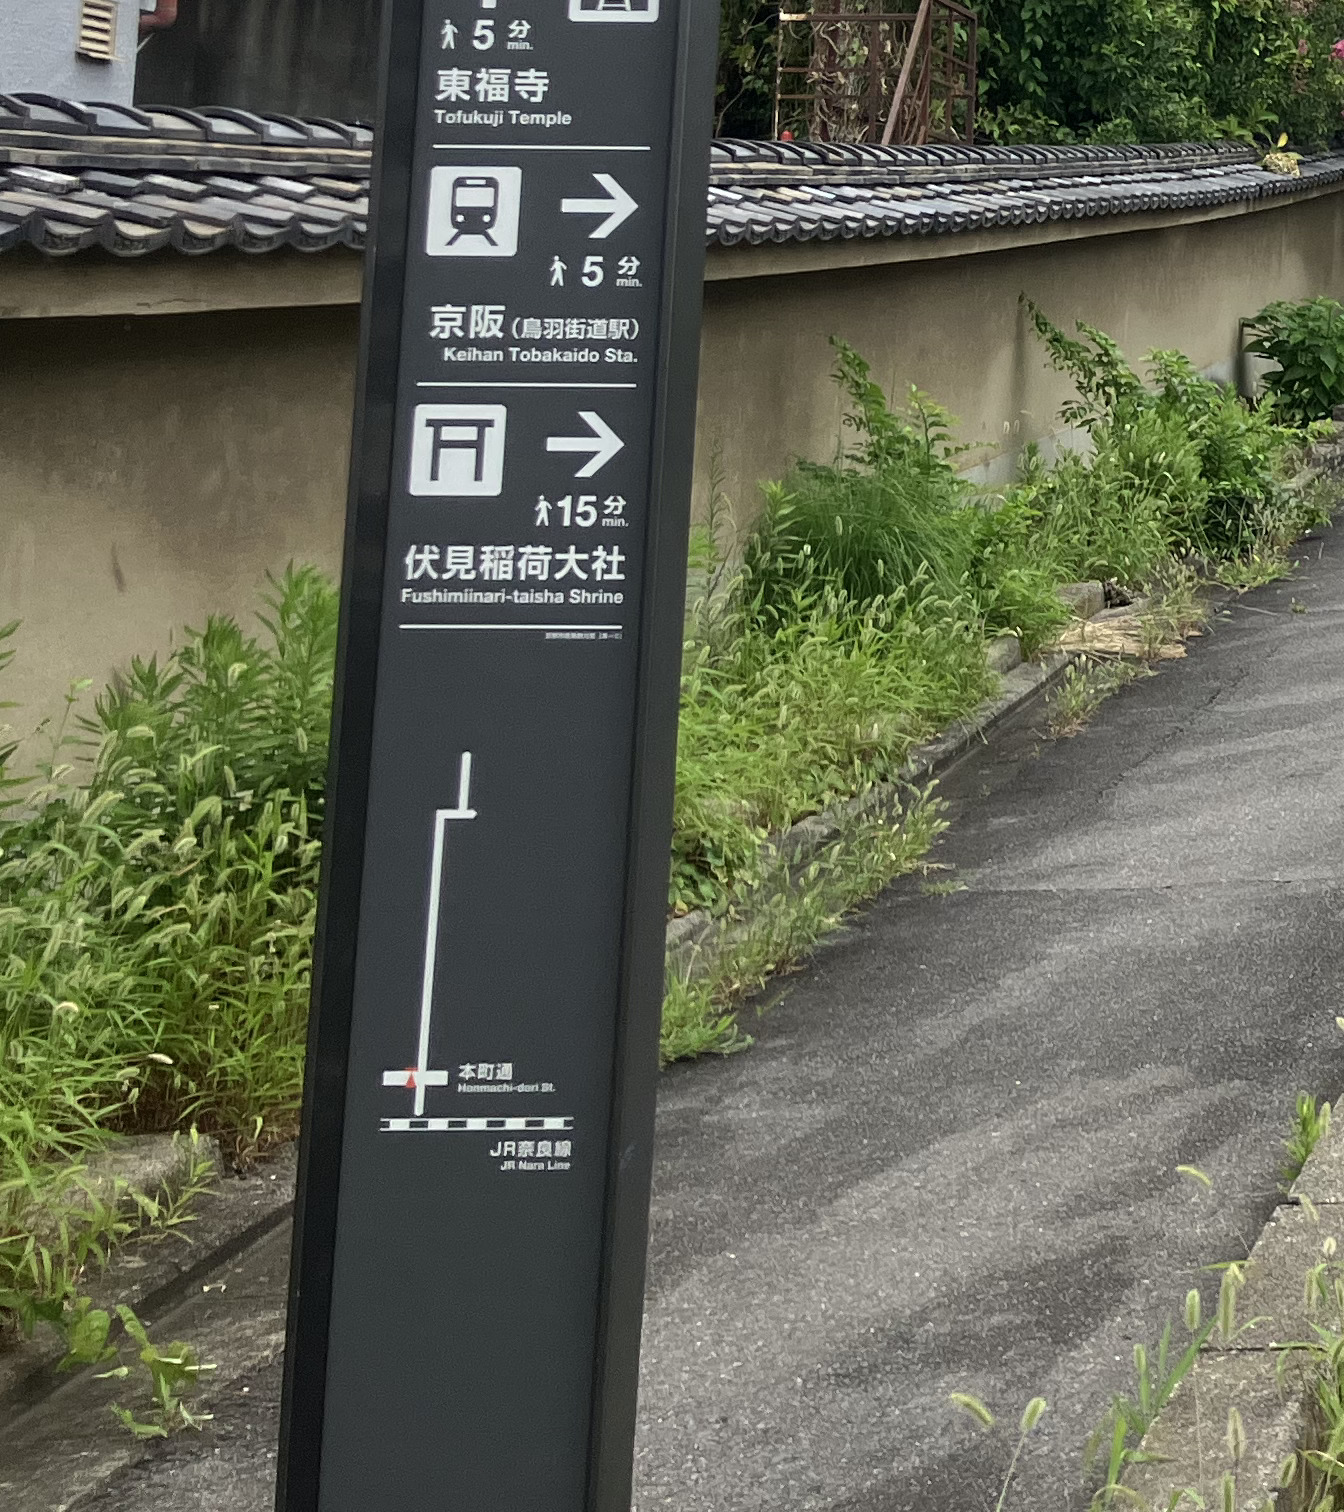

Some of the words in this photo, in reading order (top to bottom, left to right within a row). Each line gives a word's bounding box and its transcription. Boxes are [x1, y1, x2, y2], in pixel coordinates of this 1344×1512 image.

[473, 20, 494, 50] 5
[507, 40, 533, 49] min.
[435, 68, 549, 102] 東福寺
[434, 110, 503, 127] Tofukuji
[508, 110, 571, 127] Temple
[582, 256, 603, 287] 5
[616, 277, 642, 286] min.
[444, 347, 503, 361] Keihan
[509, 347, 599, 362] Tobakaido
[604, 348, 637, 362] Sta.
[557, 496, 597, 527] 15
[602, 516, 628, 526] min.
[405, 545, 625, 580] 伏見稲荷大社
[401, 588, 564, 603] Fushimiinari-taisha
[569, 589, 623, 603] Shrine
[459, 1063, 512, 1080] 本町通
[490, 1141, 571, 1157] JR奈良線
[501, 1161, 515, 1170] JR
[519, 1160, 544, 1170] Nara
[546, 1160, 570, 1170] Line
